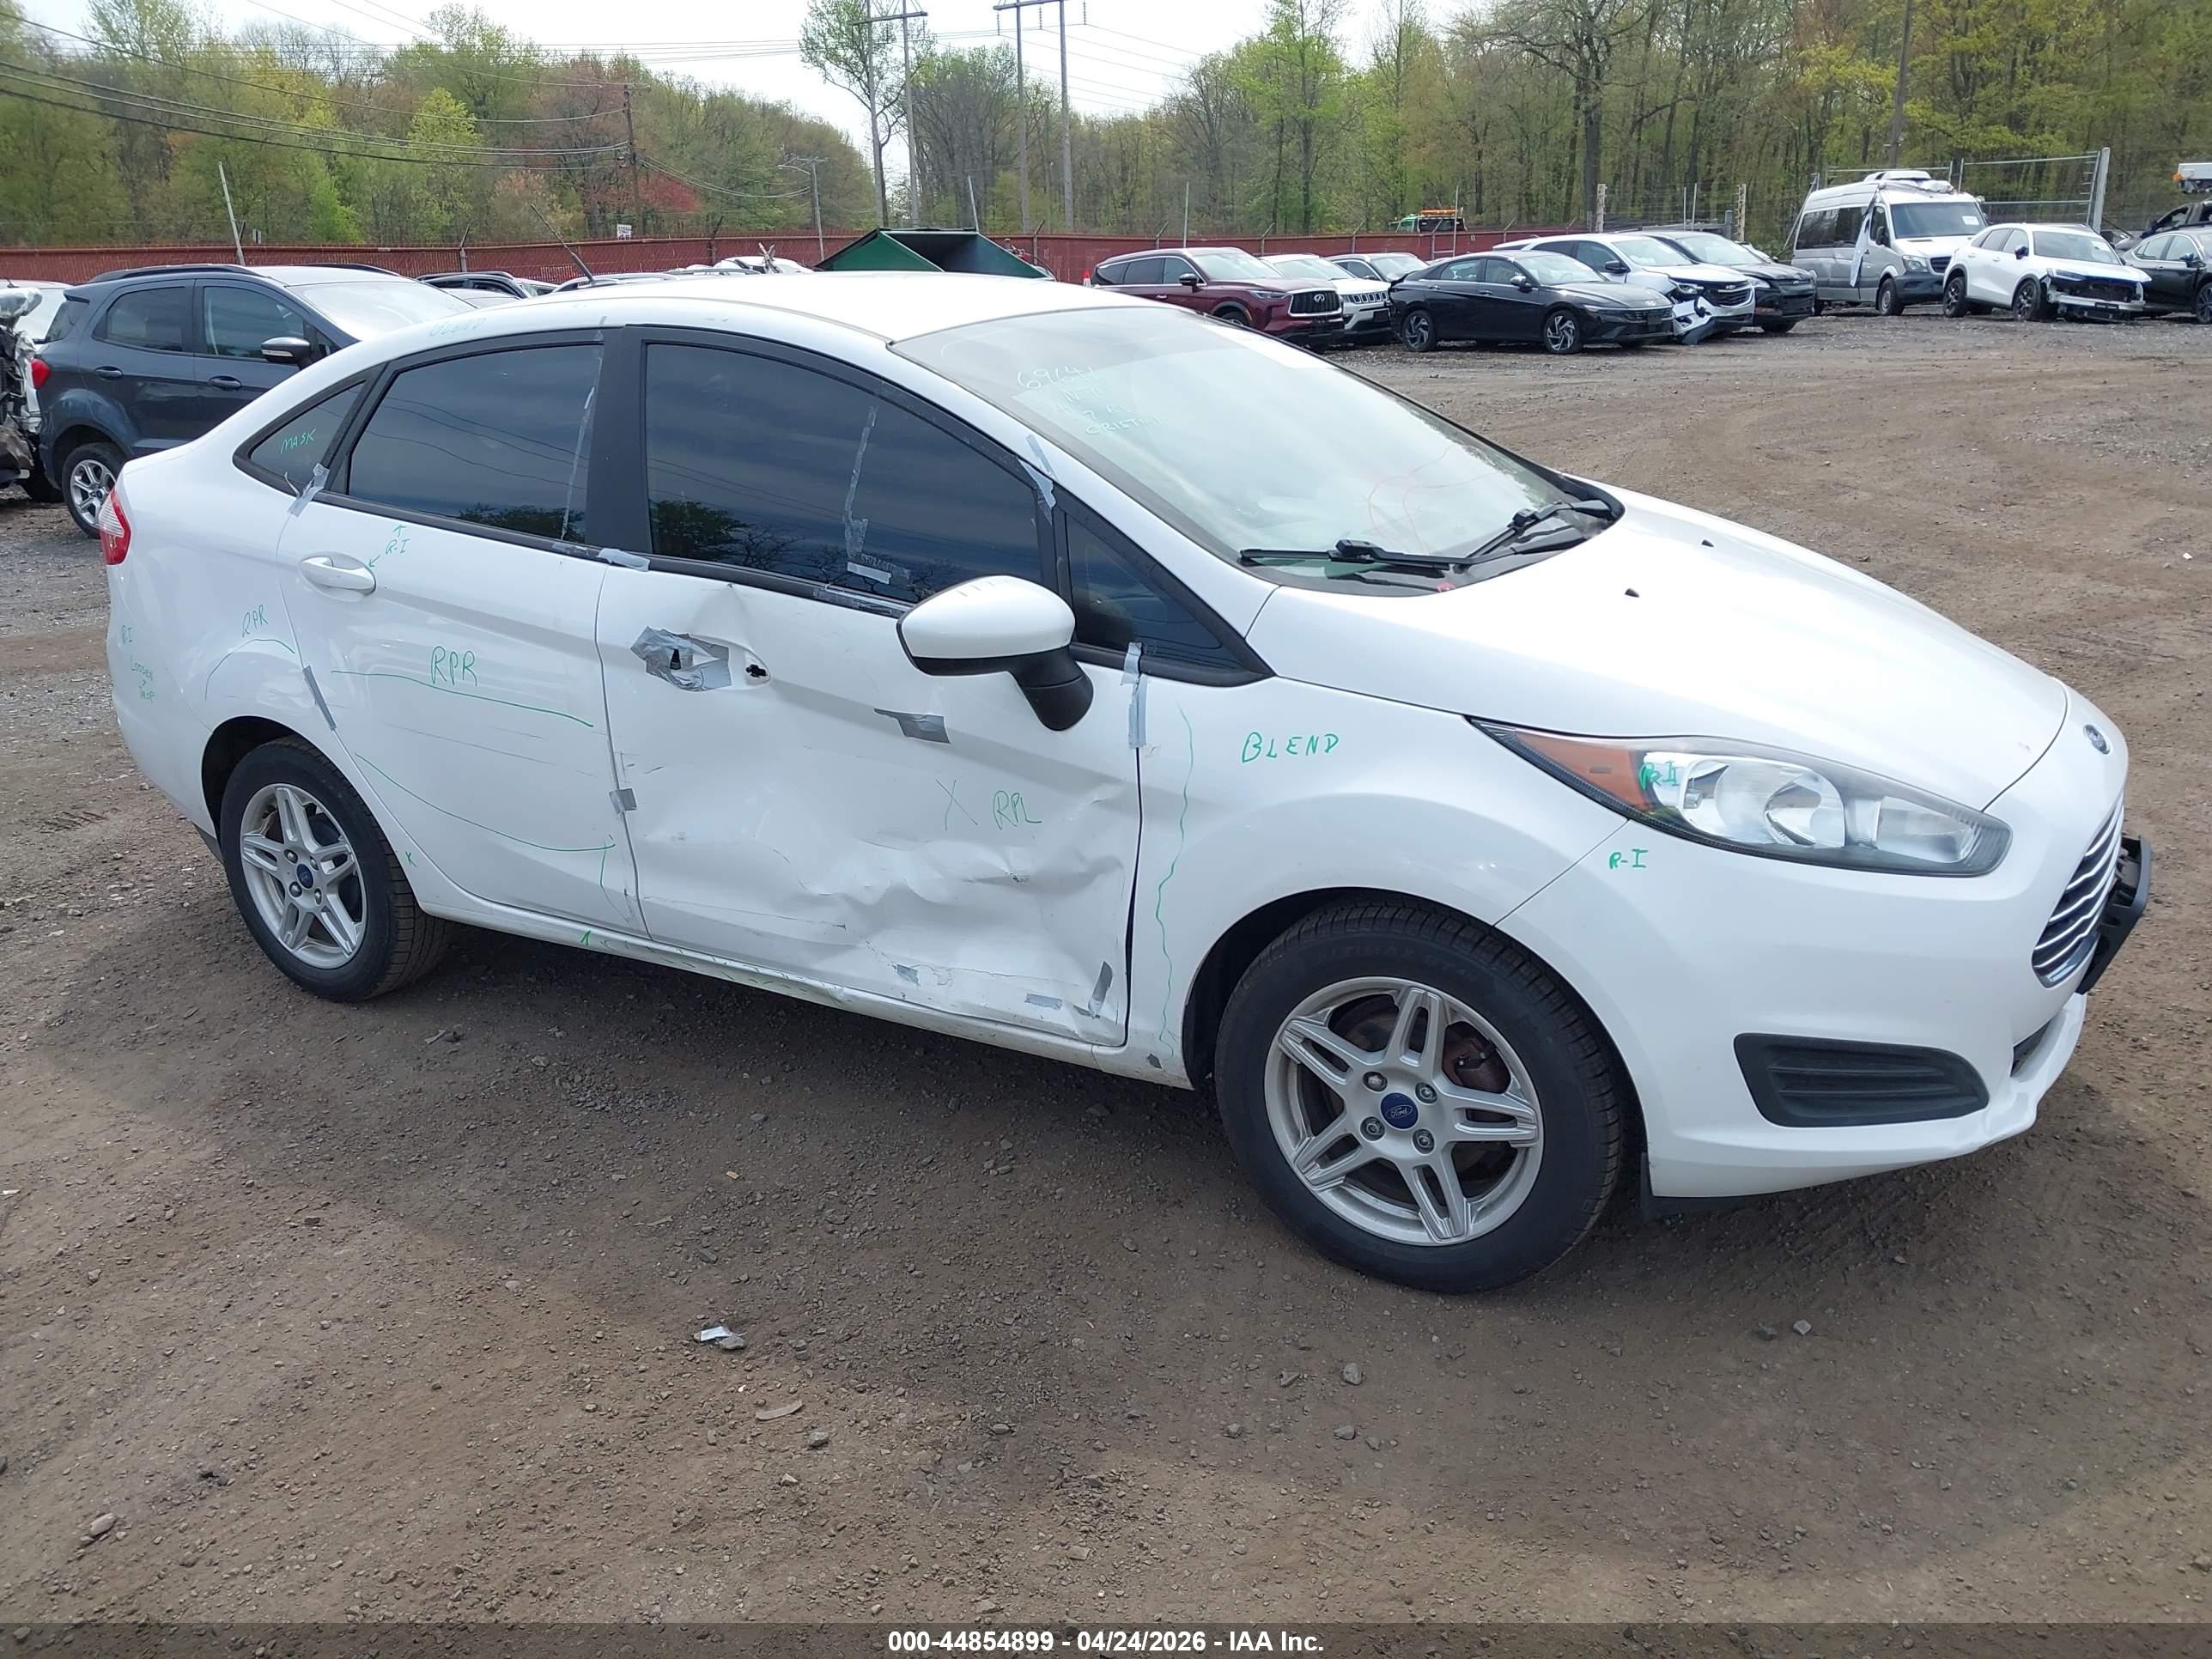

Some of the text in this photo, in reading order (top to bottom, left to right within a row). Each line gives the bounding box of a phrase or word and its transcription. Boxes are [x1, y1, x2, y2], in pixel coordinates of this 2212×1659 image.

[280, 428, 317, 454] MASK
[241, 604, 269, 638] RPR
[430, 645, 477, 687] RPR
[1242, 731, 1340, 763] BLEND
[993, 789, 1043, 830] RPL
